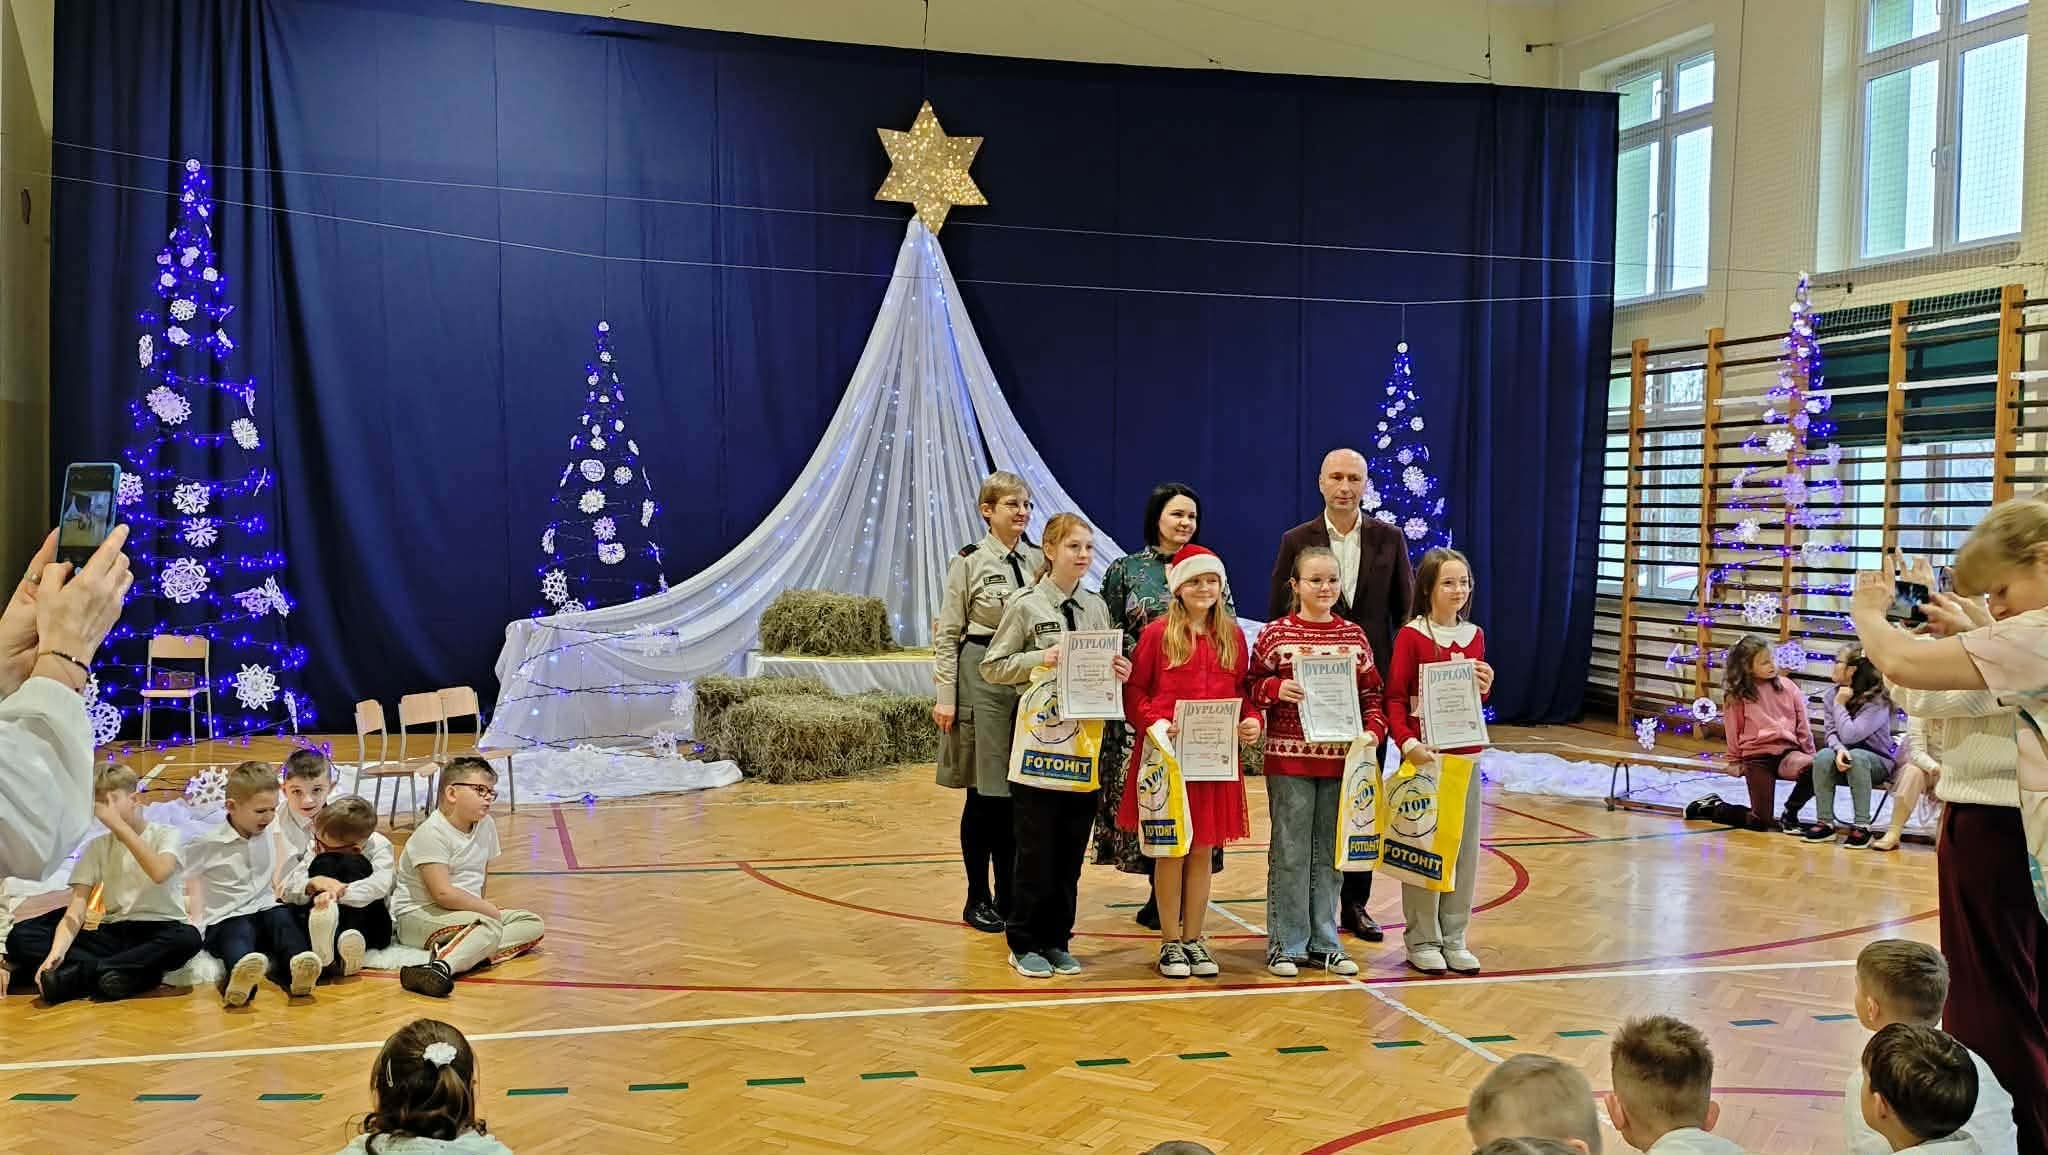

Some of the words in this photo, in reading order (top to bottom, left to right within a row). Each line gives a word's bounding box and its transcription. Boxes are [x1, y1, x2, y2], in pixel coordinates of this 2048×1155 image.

[1071, 638, 1115, 650] DYPLOM
[1304, 662, 1349, 675] DYPLOM
[1430, 667, 1471, 683] DYPLOM
[1187, 703, 1234, 716] DYPLOM
[1025, 755, 1090, 774] FOTOHIT
[1384, 844, 1442, 872] FOTOHIT
